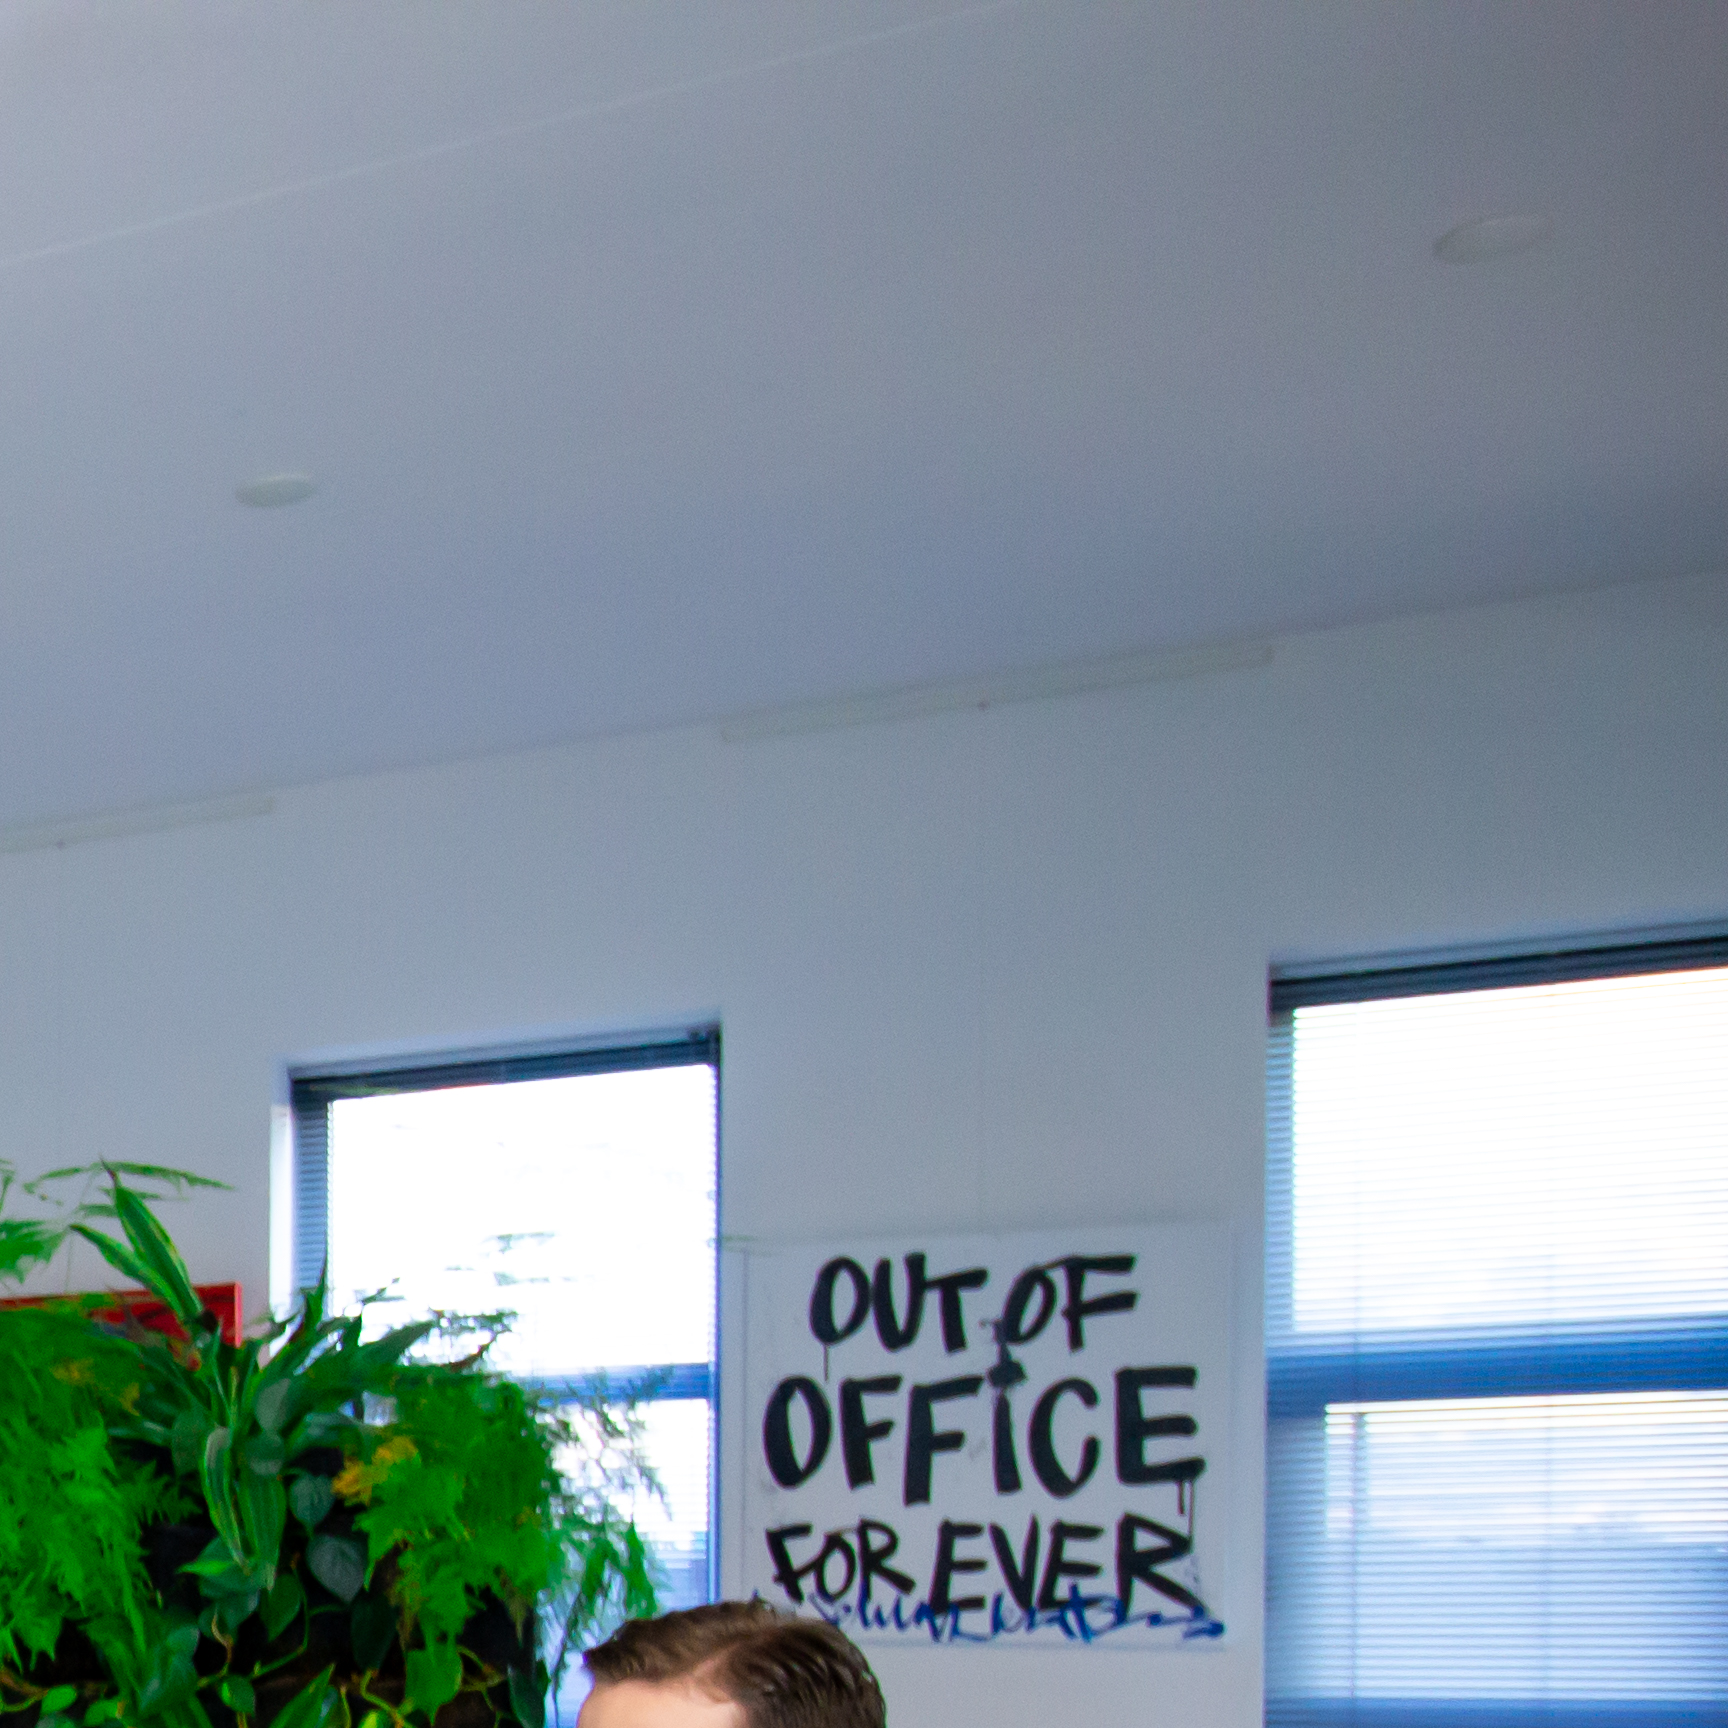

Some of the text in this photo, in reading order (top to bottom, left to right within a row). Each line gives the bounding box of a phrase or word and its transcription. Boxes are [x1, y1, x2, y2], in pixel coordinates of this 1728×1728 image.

[810, 1252, 1138, 1354] OUT OF
[763, 1366, 1206, 1507] OFFICE
